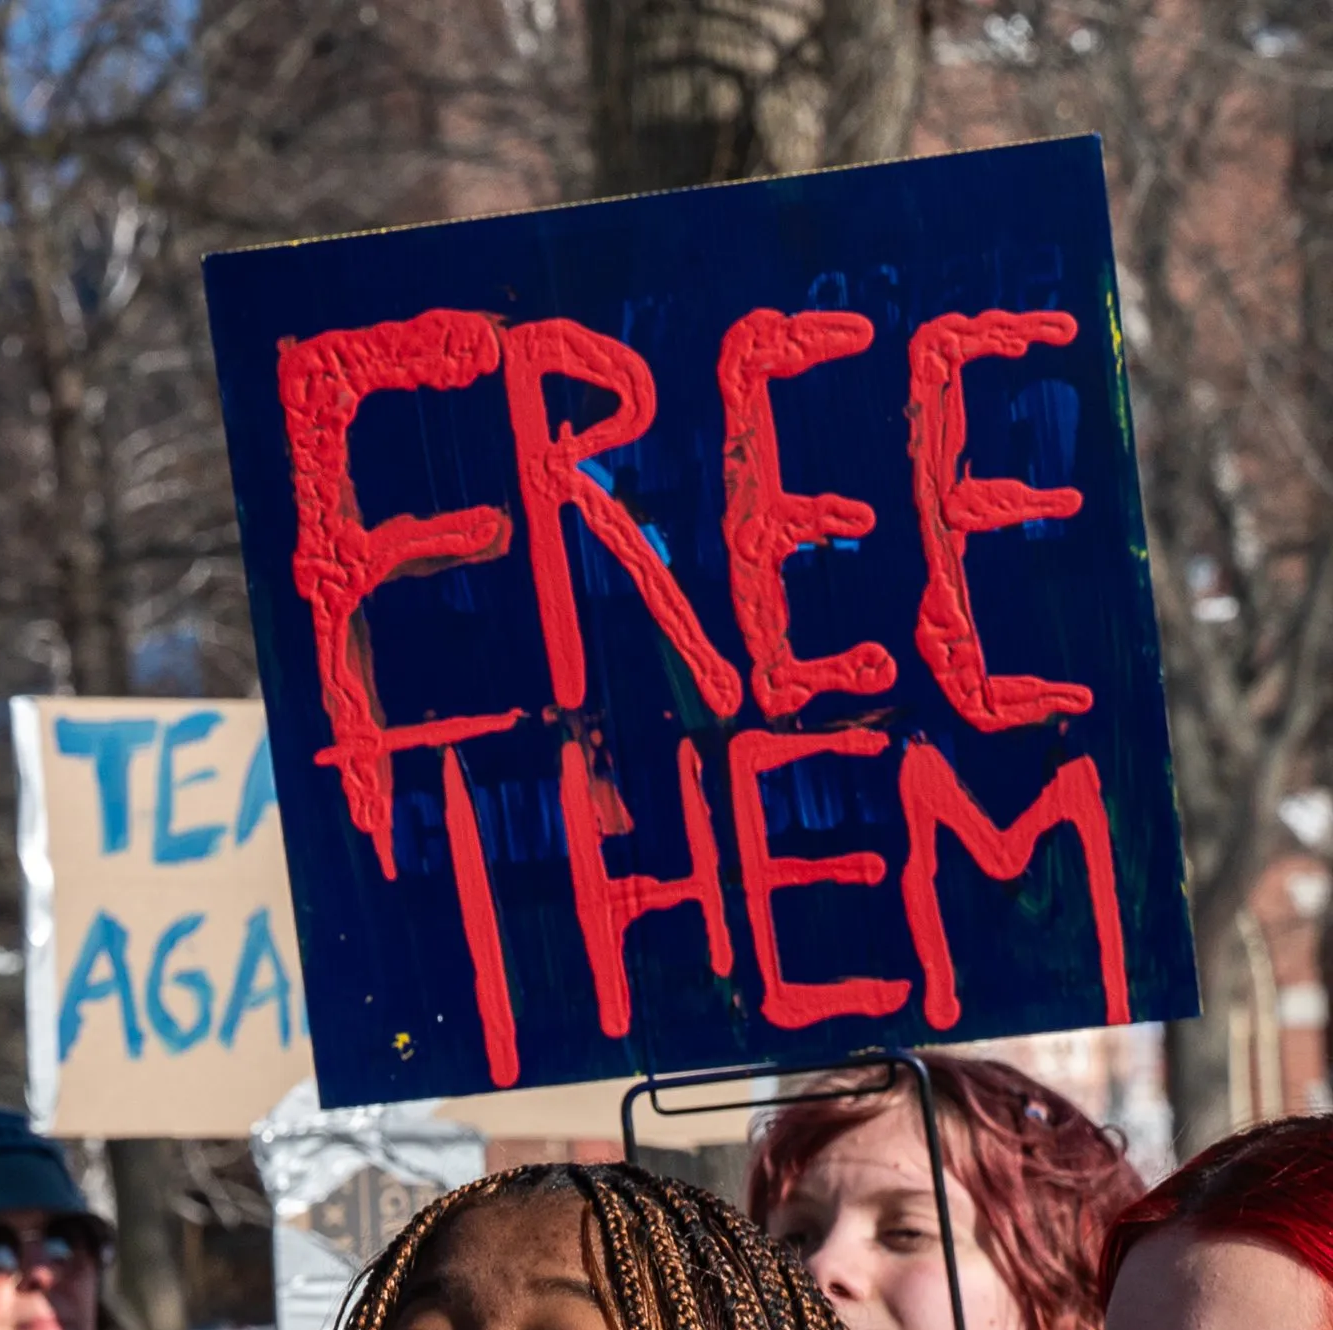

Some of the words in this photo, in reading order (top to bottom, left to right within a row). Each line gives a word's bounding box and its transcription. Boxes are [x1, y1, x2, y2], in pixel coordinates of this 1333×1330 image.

[278, 307, 1093, 878] FREE
[57, 906, 311, 1064] AGA
[314, 706, 1129, 1088] THEM
